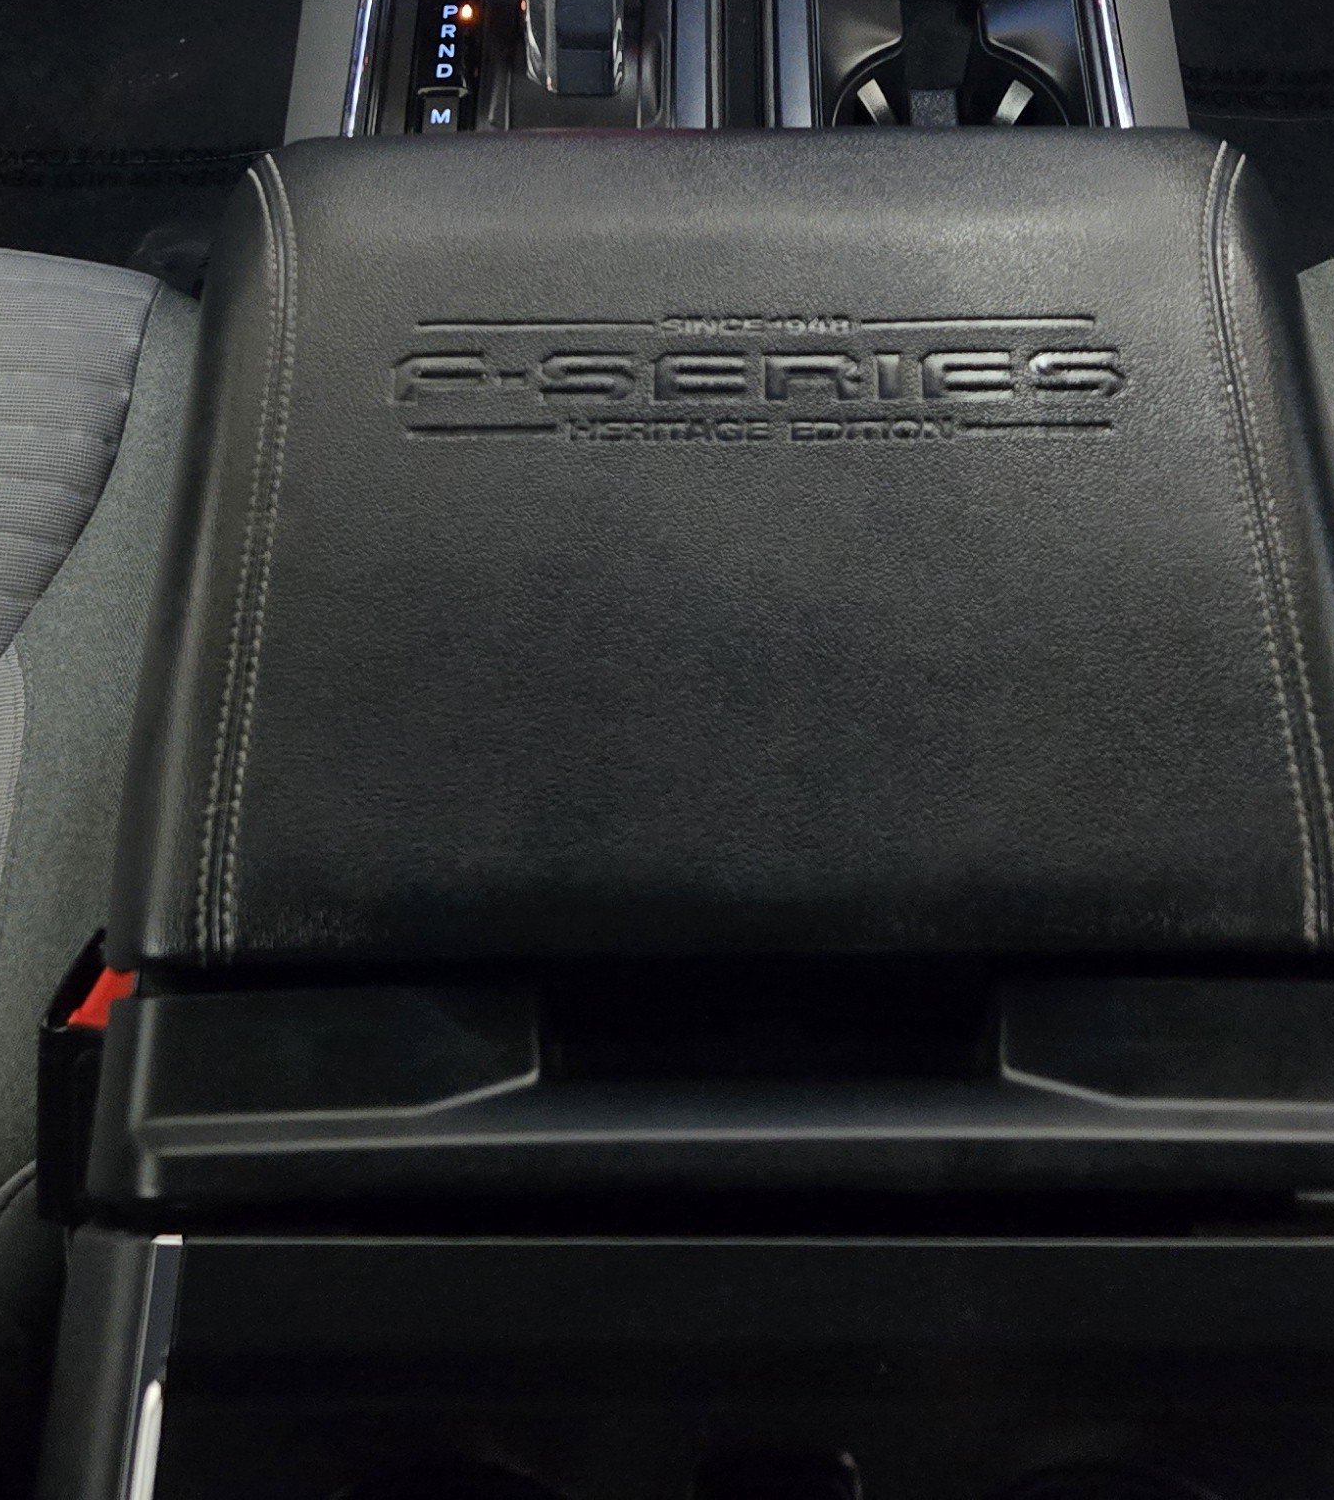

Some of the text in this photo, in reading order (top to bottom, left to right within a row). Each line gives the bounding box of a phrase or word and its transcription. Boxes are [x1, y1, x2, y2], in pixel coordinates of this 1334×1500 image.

[442, 4, 458, 19] P
[440, 24, 457, 39] R
[438, 43, 455, 58] N
[435, 63, 452, 78] D
[430, 109, 451, 124] M
[660, 315, 765, 338] SINCE
[389, 349, 1127, 403] F-SERIES
[567, 417, 770, 443] HERITAGE
